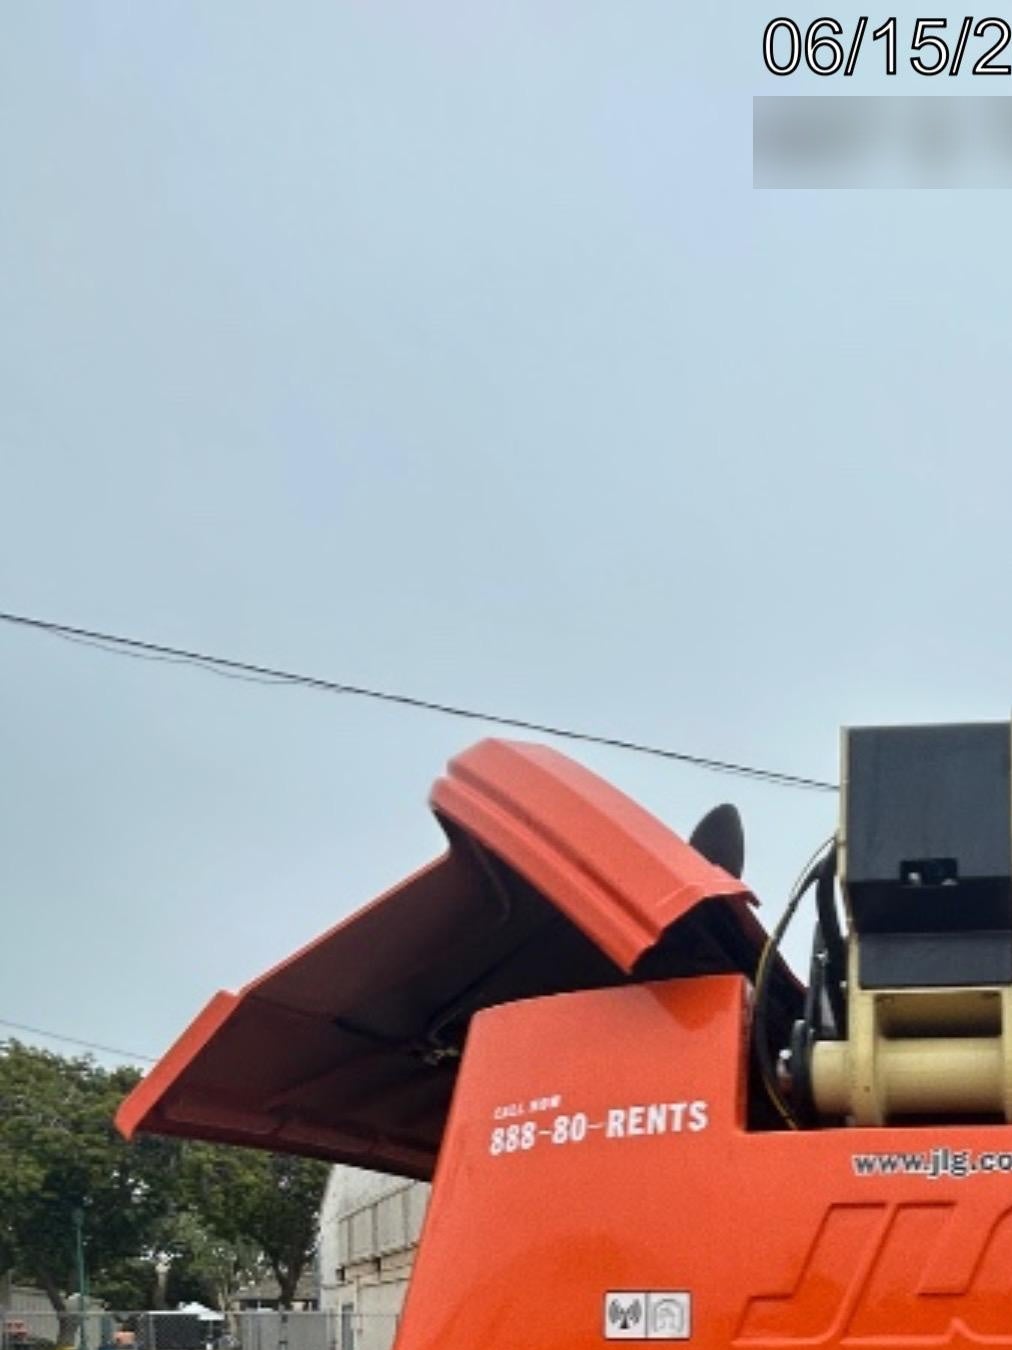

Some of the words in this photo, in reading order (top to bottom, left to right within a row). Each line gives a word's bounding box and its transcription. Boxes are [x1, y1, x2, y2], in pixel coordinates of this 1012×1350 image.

[493, 1103, 525, 1120] CALL
[528, 1094, 562, 1113] NOW
[489, 1100, 709, 1156] 888-80-RENTS
